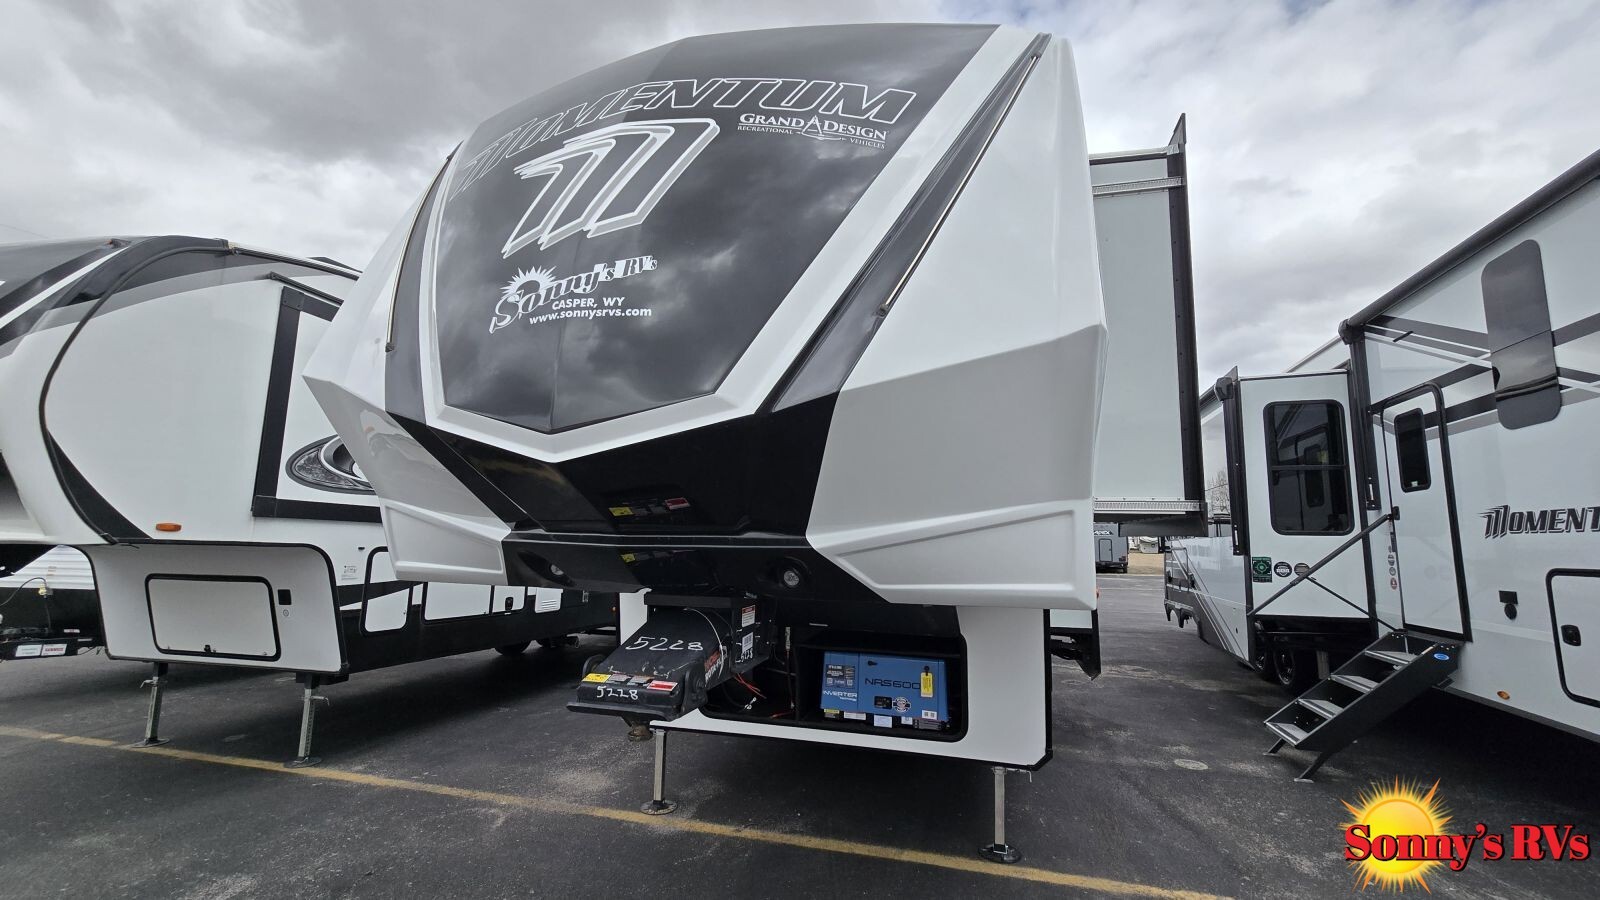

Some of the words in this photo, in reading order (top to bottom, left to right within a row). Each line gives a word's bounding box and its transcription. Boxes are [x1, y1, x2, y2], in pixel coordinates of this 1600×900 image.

[739, 113, 805, 128] GRAND
[823, 119, 887, 140] DESIGN
[448, 78, 917, 202] MOMENTUM
[737, 125, 794, 135] RECREATIONAL
[850, 137, 885, 149] VEHICLES
[488, 262, 617, 334] Sonny's
[616, 255, 658, 279] RVs
[551, 297, 598, 310] CASPER,
[603, 296, 625, 307] WY
[529, 307, 652, 324] www.sonnysrvs.com
[625, 636, 704, 651] 5228
[596, 685, 639, 700] 5228
